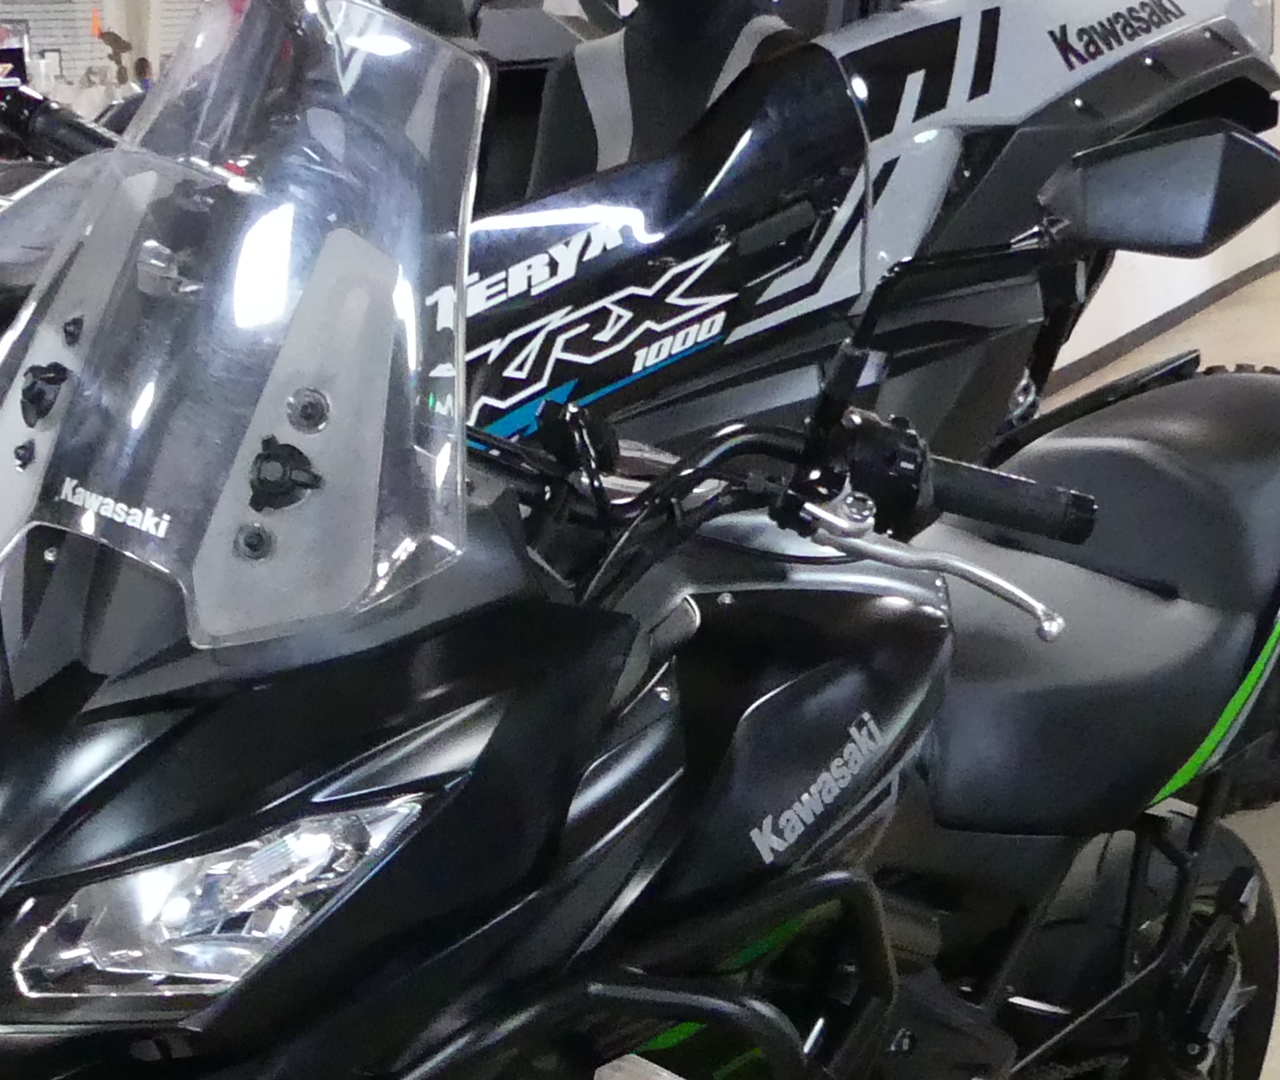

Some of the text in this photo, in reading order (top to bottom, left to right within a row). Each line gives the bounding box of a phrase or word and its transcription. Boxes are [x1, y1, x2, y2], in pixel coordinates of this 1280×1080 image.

[1047, 0, 1186, 72] Kawasaki
[631, 311, 727, 374] 1000
[59, 476, 172, 538] Kawasaki
[749, 711, 887, 865] Kawasaki
